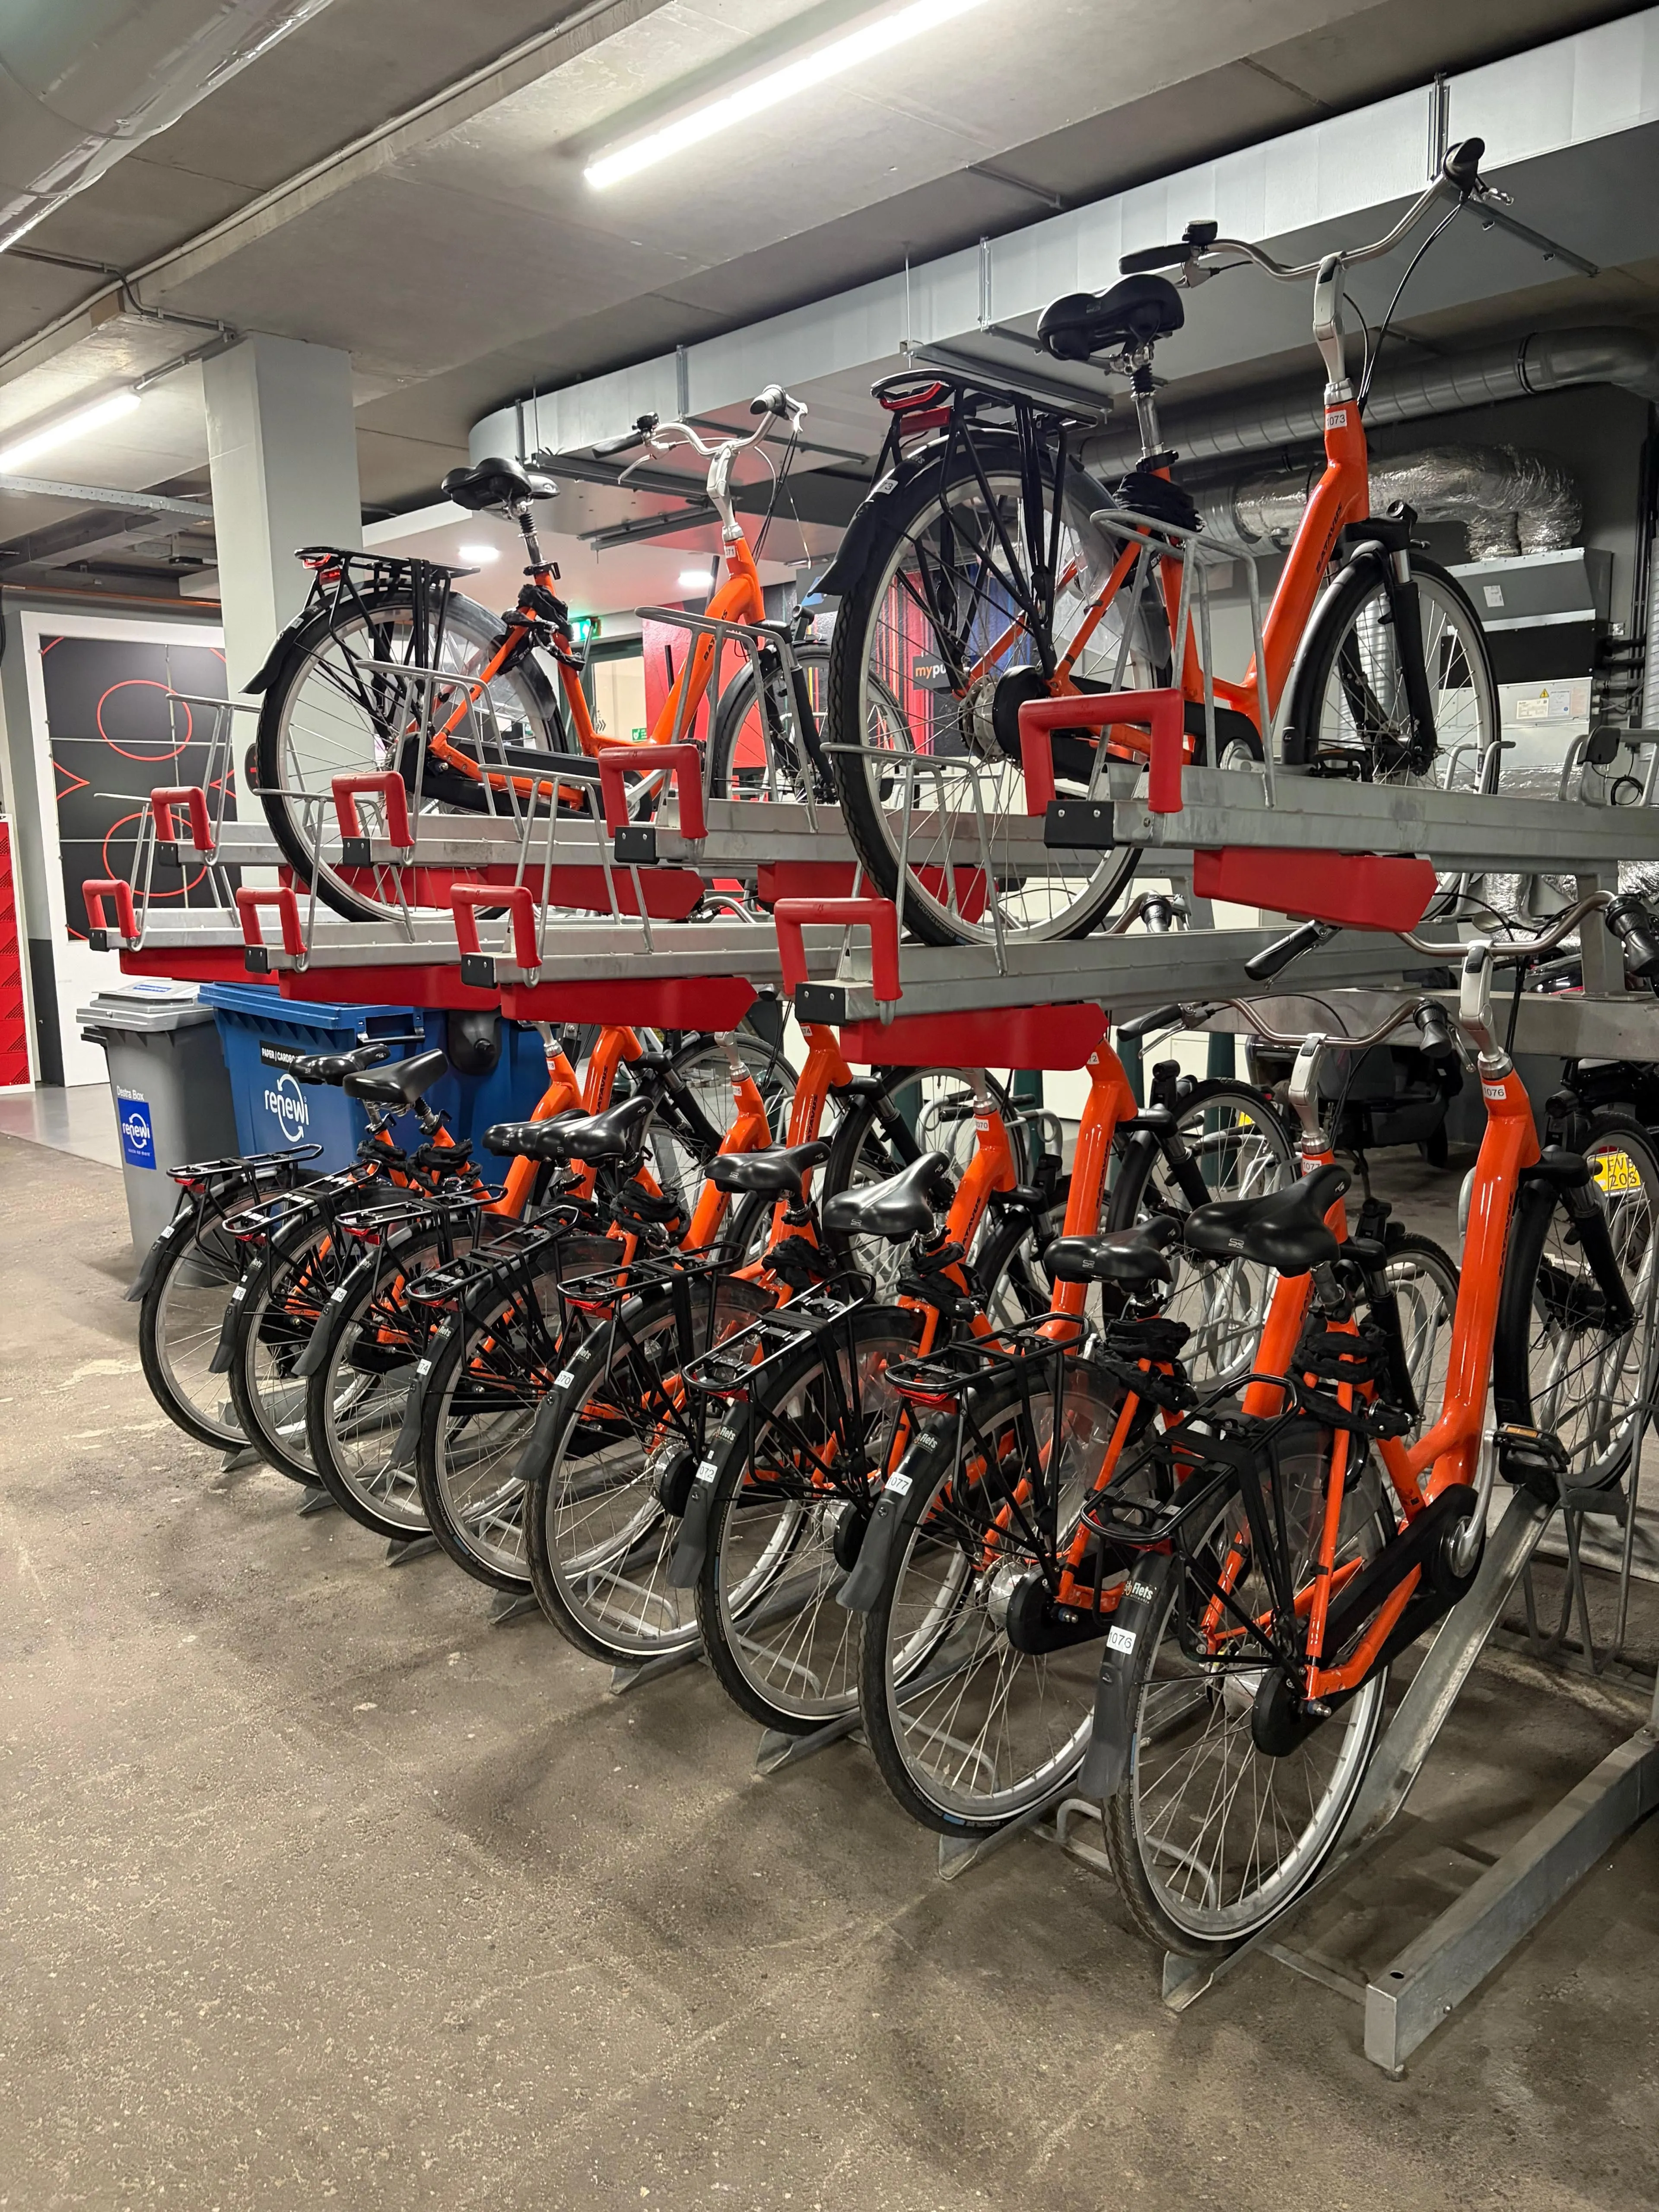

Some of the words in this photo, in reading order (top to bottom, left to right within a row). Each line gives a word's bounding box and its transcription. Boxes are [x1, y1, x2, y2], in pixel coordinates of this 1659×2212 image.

[1327, 414, 1345, 426] 1073
[915, 664, 946, 679] mypu
[262, 1048, 275, 1059] PAPER
[278, 1052, 296, 1064] CARDBO
[116, 1085, 132, 1099] Destra
[132, 1089, 145, 1102] Box
[1484, 1087, 1505, 1097] 1076
[807, 1094, 818, 1142] ATAVUS
[963, 1196, 981, 1246] ATAVUS
[557, 1374, 571, 1385] 070
[720, 1426, 736, 1441] Fiets
[919, 1433, 938, 1449] Fiets
[887, 1477, 909, 1490] 1077
[1131, 1582, 1154, 1601] Fiets
[1109, 1631, 1133, 1649] 1076
